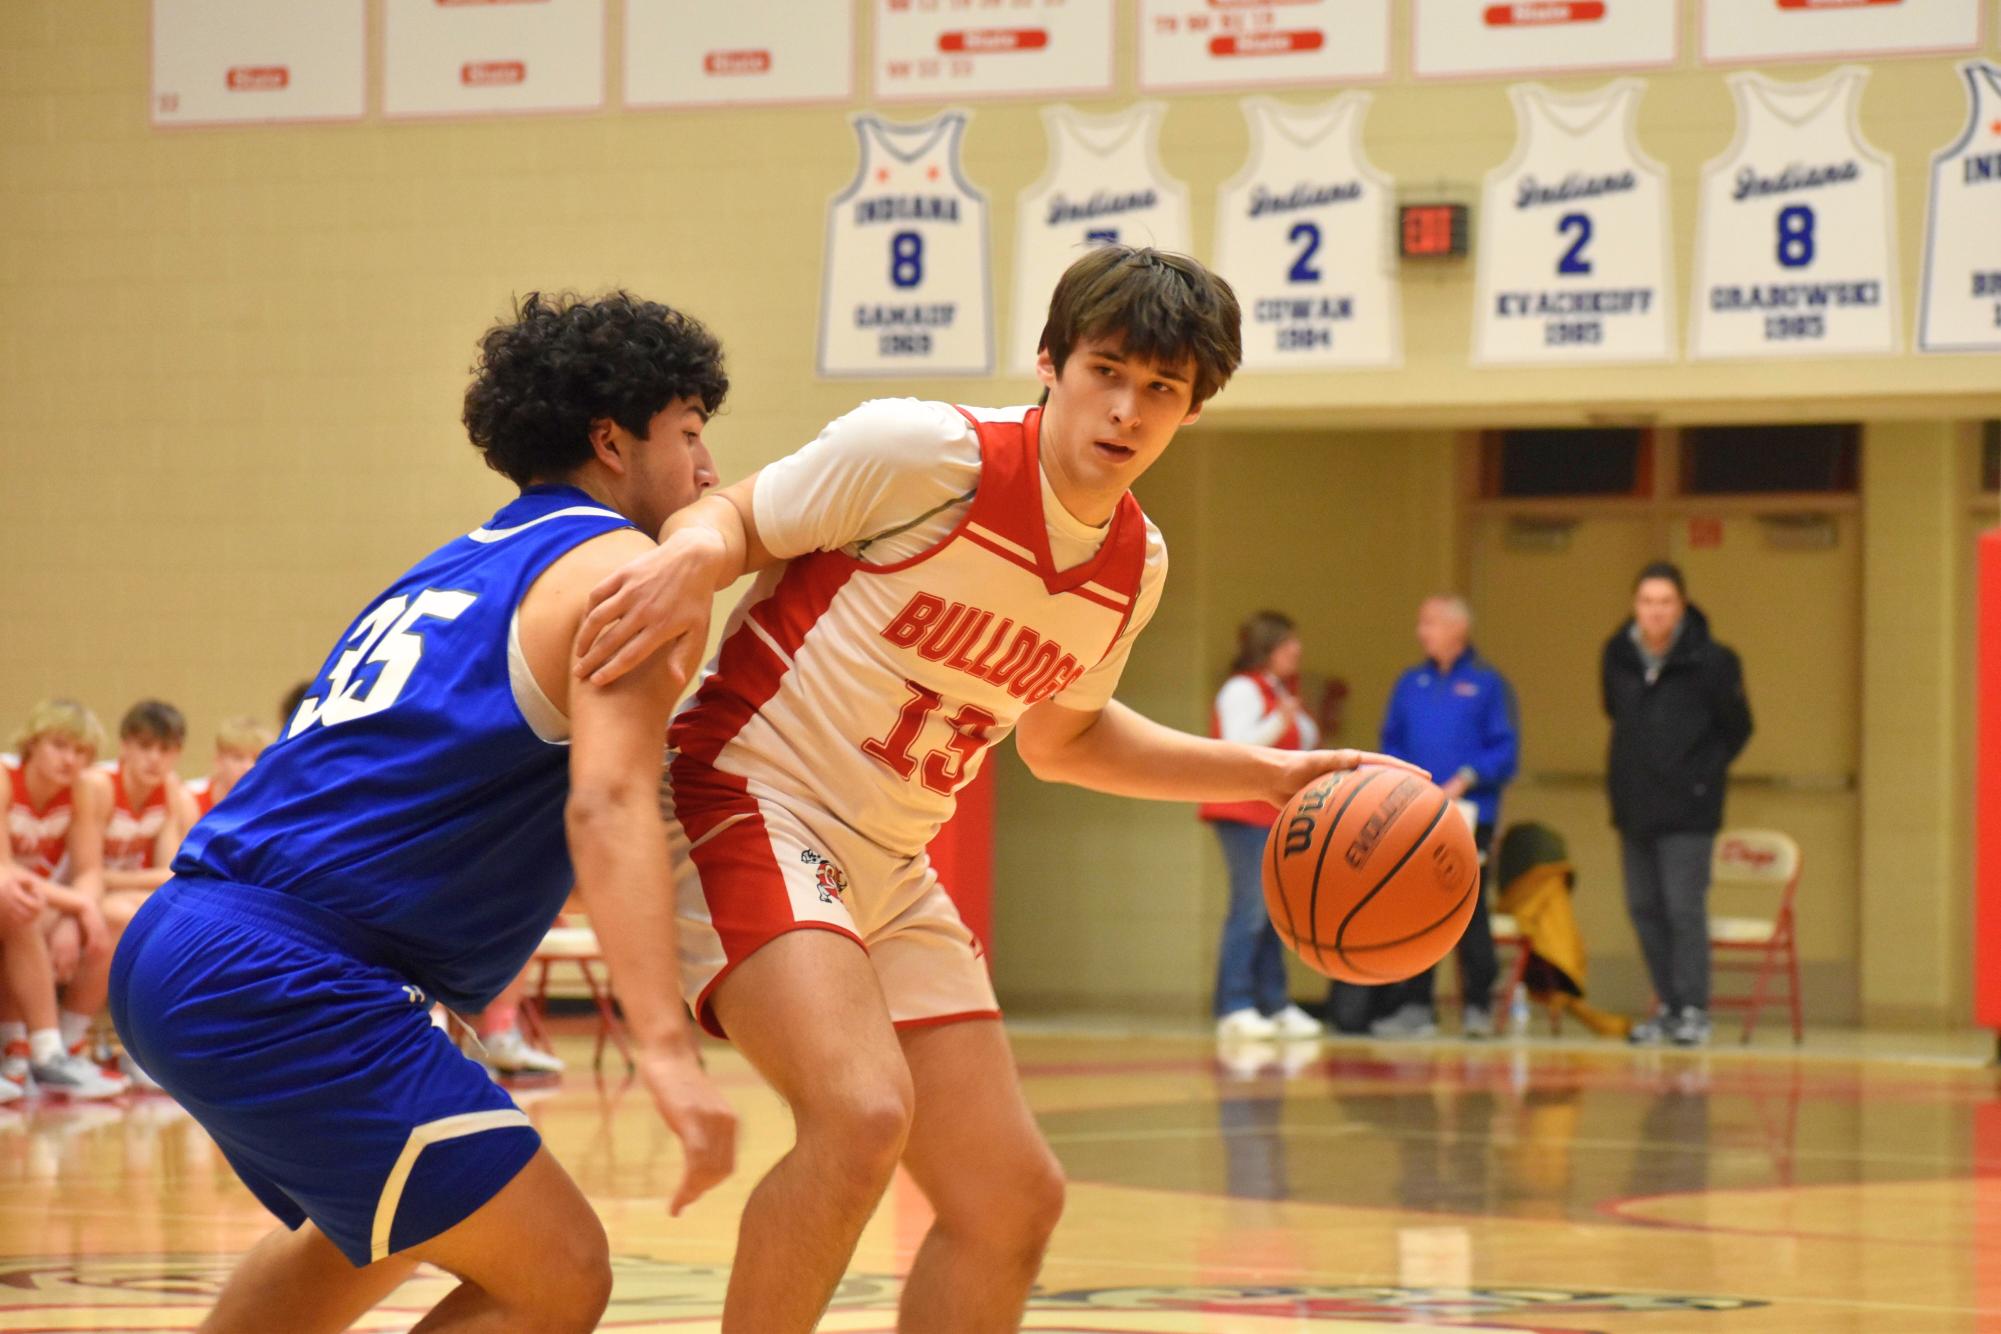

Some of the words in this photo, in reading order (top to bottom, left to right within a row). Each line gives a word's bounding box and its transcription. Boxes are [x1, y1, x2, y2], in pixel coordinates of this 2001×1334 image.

[1045, 185, 1159, 226] Indiana
[1247, 181, 1364, 219] Indiana
[1515, 171, 1638, 209] Indiana
[1731, 161, 1859, 202] Indiana
[855, 197, 961, 226] INDIANA
[1777, 204, 1815, 269] 8
[891, 230, 924, 289] 8
[1286, 221, 1323, 283] 2
[1556, 213, 1594, 276] 2
[287, 586, 479, 741] 35
[860, 678, 999, 797] 13
